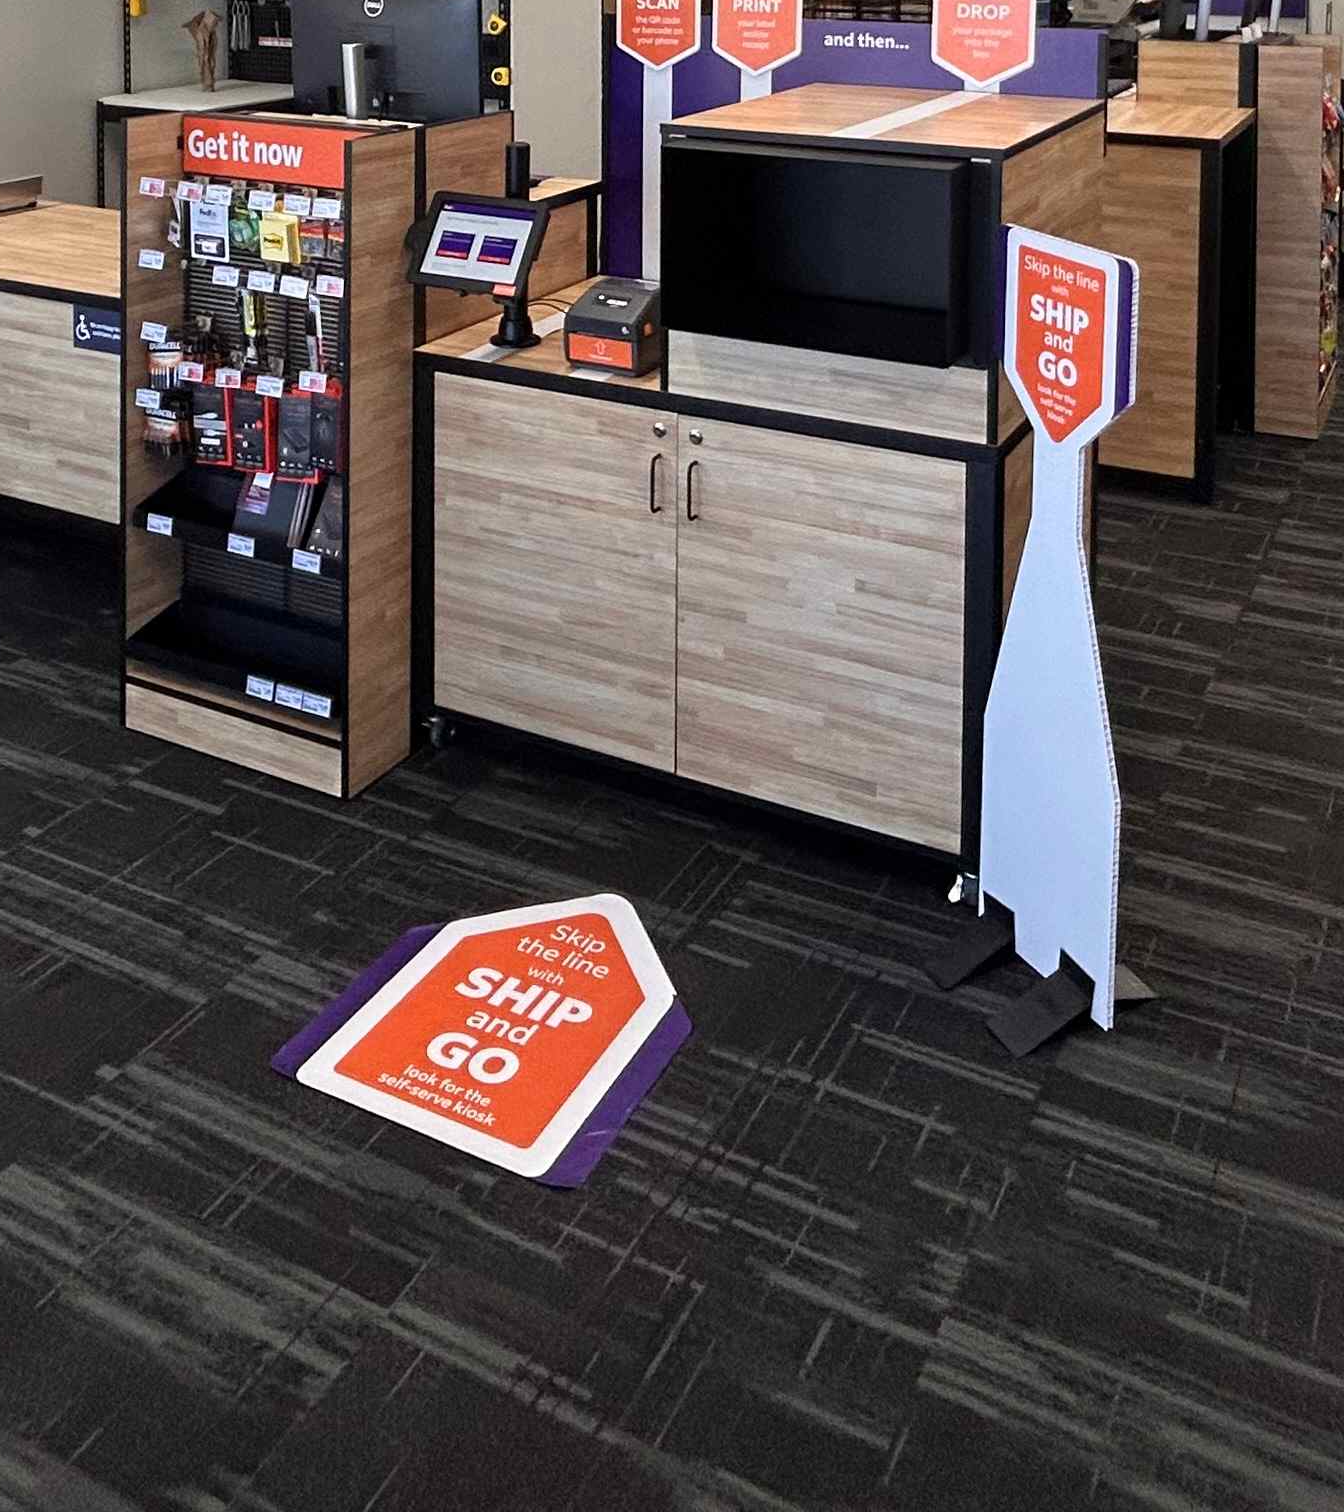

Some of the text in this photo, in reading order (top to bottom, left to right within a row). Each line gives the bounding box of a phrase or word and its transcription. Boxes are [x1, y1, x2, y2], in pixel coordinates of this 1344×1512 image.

[957, 4, 1010, 20] DROP
[824, 32, 909, 50] and then...
[188, 129, 303, 168] Get it now
[1024, 255, 1100, 293] Skip the line
[1030, 293, 1089, 335] SHIP
[1044, 331, 1073, 354] and
[1037, 351, 1078, 388] GO
[516, 936, 609, 979] the line
[550, 924, 606, 954] Skip
[528, 966, 564, 986] with
[454, 967, 593, 1029] SHIP
[465, 1010, 540, 1046] and
[426, 1032, 520, 1084] GO
[377, 1072, 496, 1127] self-serve kiosk
[403, 1064, 491, 1107] look for the
